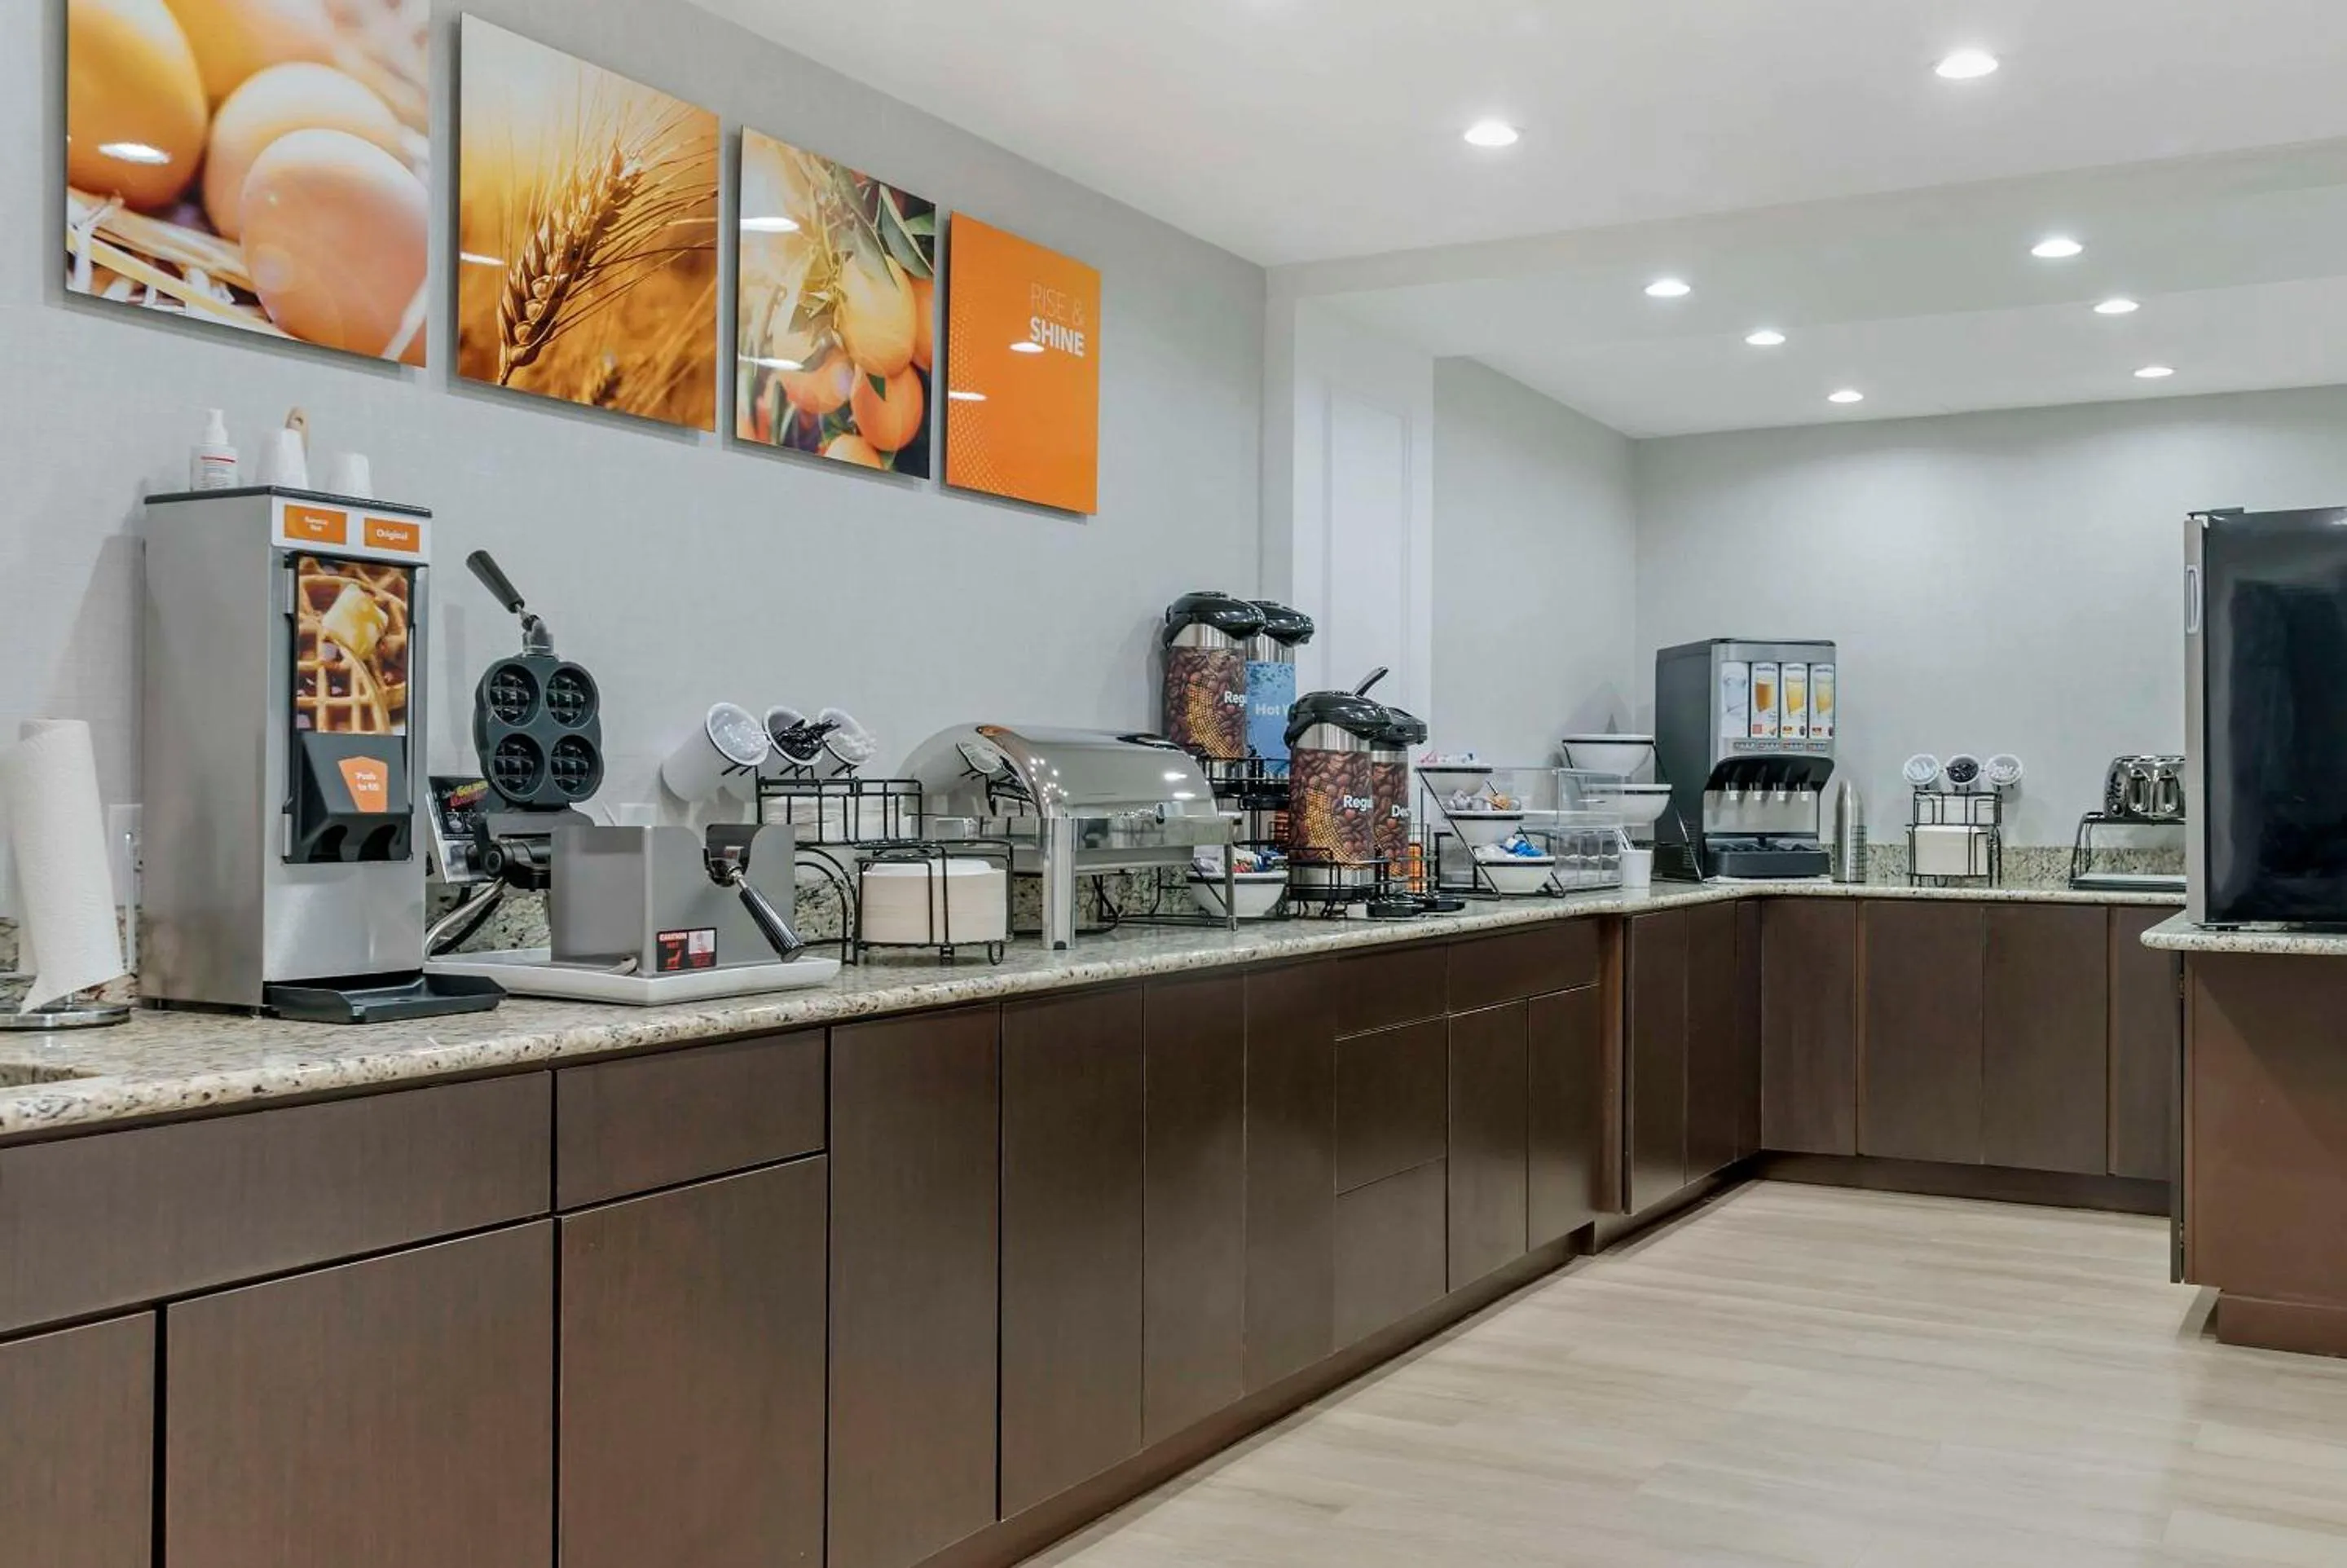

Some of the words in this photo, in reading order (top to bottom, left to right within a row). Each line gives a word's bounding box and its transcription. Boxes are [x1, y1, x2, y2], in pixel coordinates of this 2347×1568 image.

[1030, 283, 1067, 322] RISE
[1072, 298, 1085, 326] &
[1030, 315, 1085, 358] SHINE
[376, 527, 408, 541] Original
[1255, 703, 1281, 716] Hot
